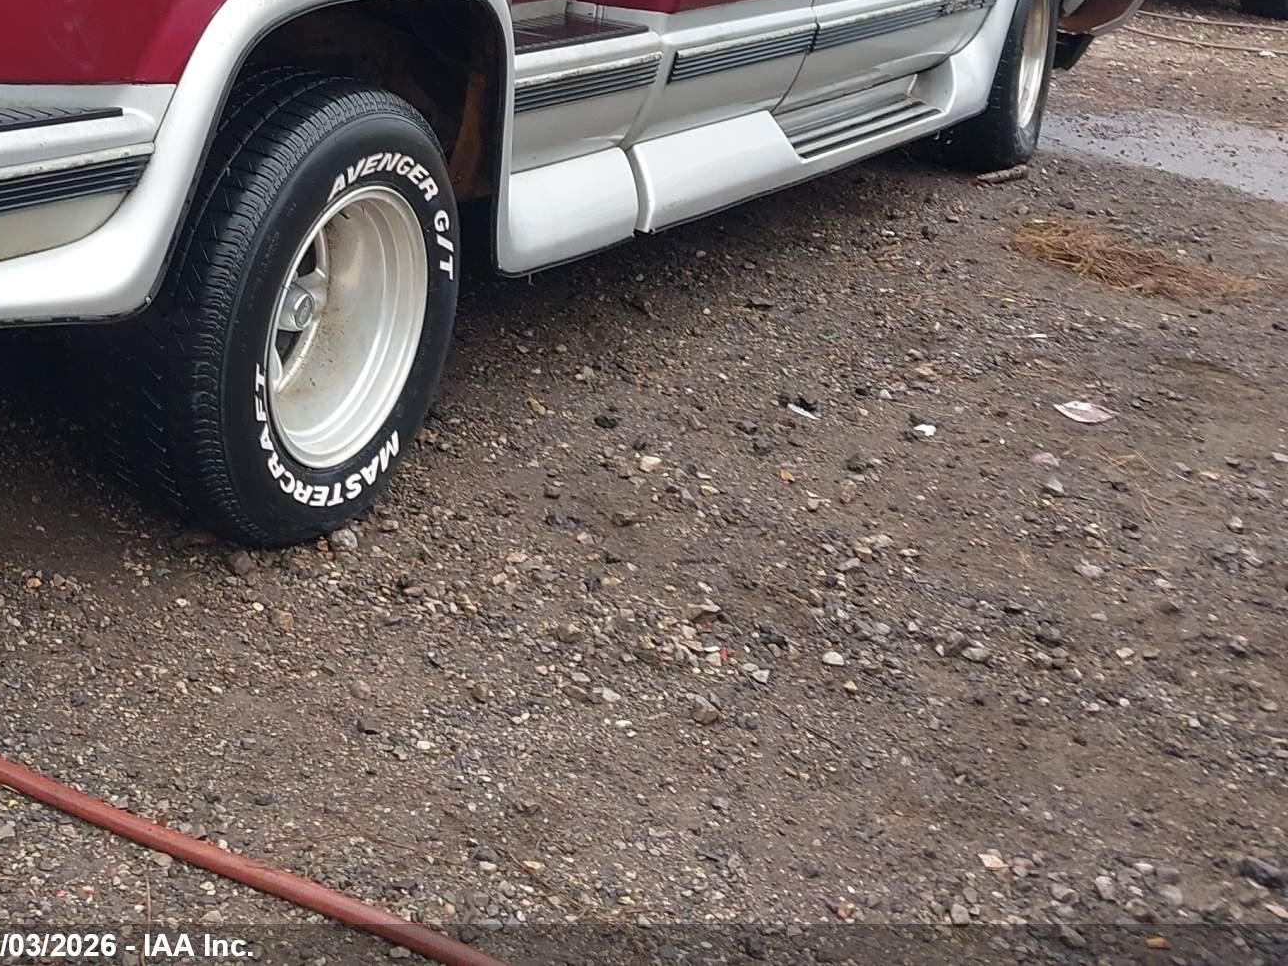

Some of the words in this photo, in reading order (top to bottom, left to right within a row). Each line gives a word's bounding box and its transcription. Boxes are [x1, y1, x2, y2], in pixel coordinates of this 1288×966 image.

[325, 152, 439, 203] AVENGER
[433, 209, 455, 281] G/T
[254, 361, 400, 507] MASTERCRAFT
